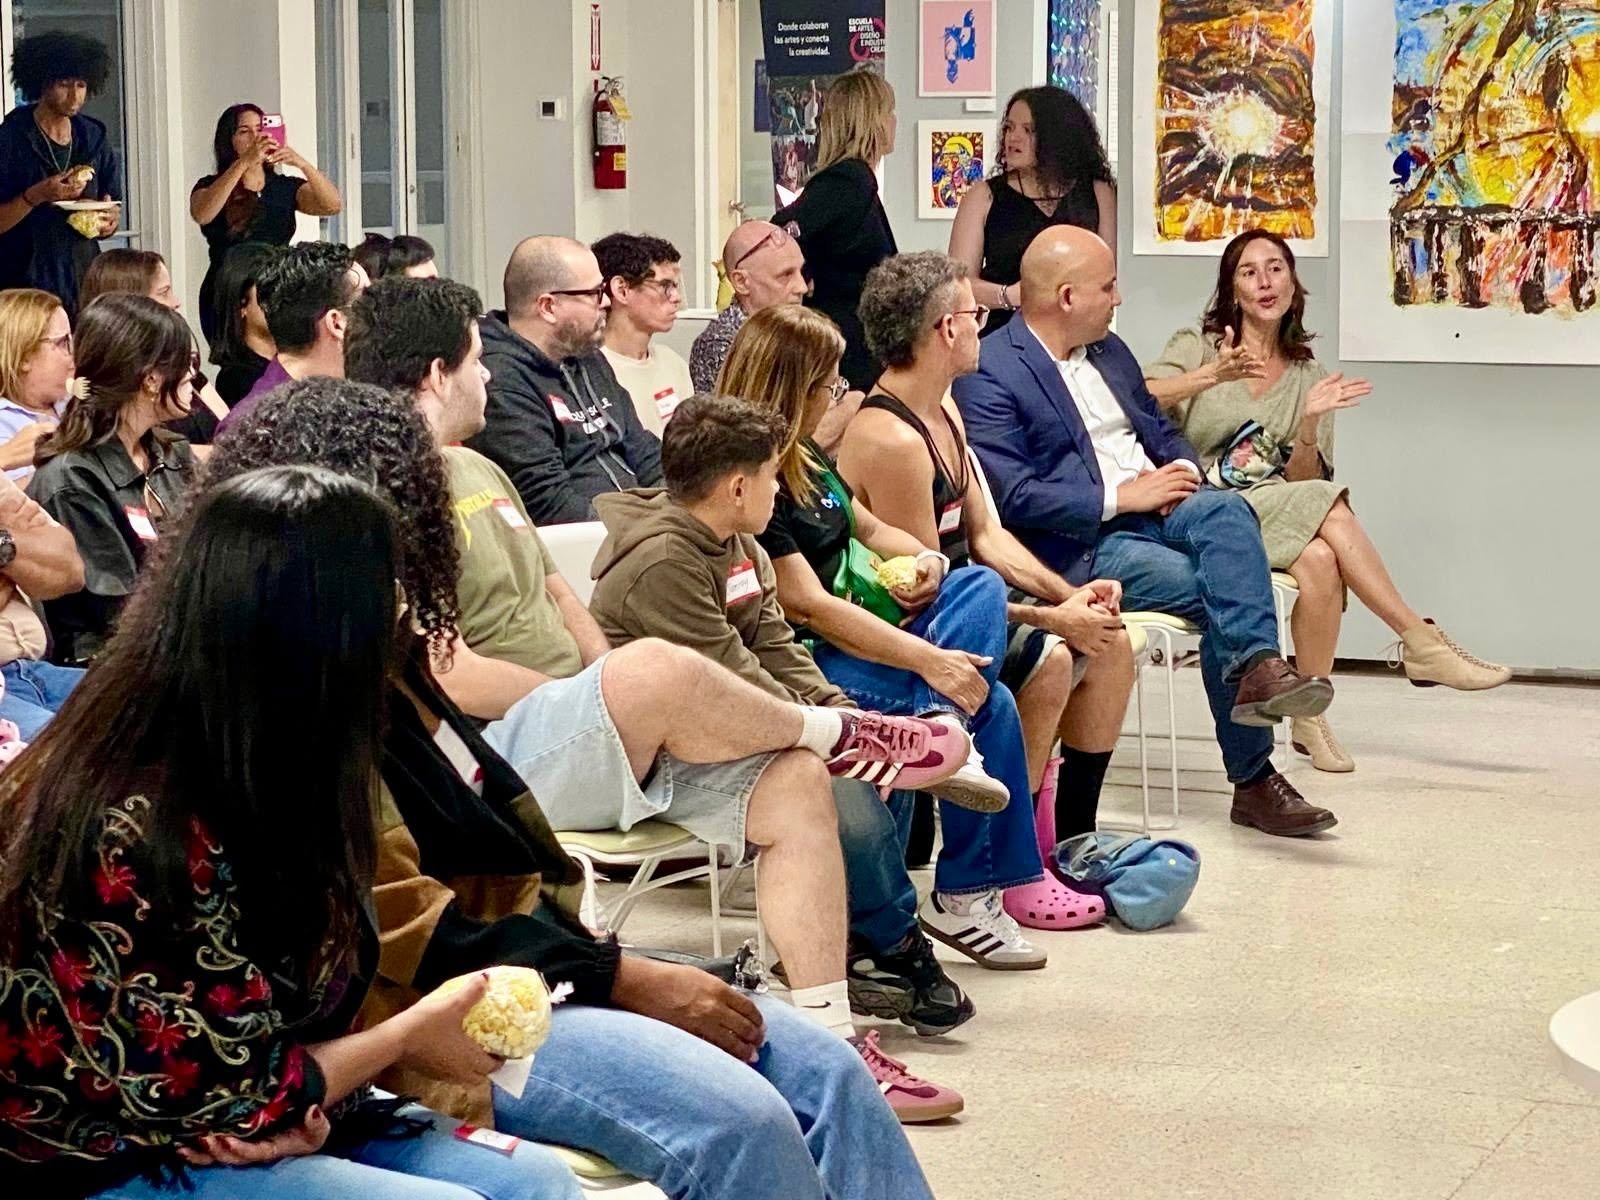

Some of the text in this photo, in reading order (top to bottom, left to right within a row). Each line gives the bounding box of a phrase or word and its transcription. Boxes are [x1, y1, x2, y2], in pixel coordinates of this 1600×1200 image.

[778, 21, 829, 31] Donde colaboran
[774, 34, 830, 45] las artes y conecta
[788, 46, 830, 56] la creatividad.
